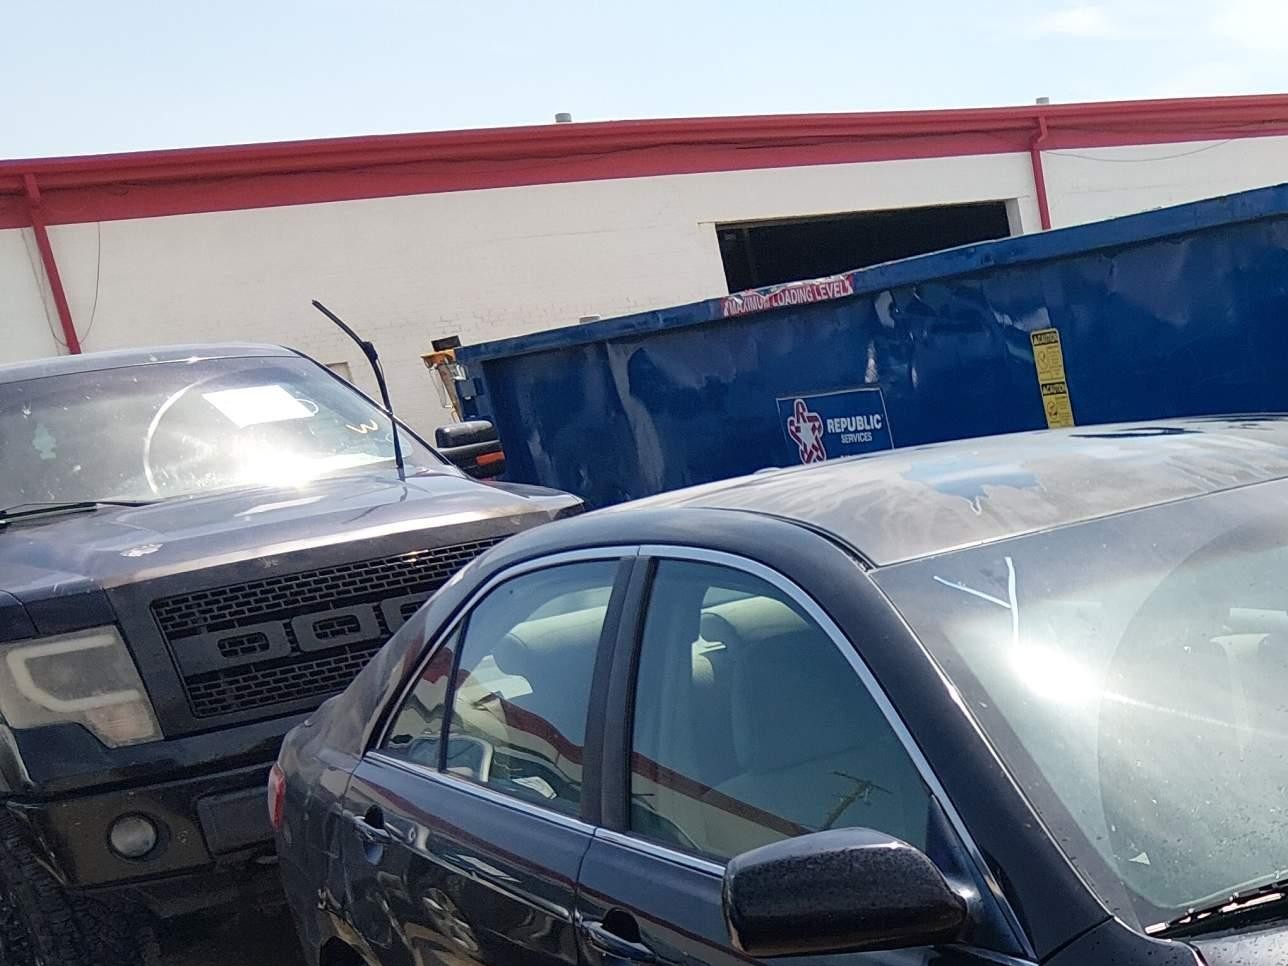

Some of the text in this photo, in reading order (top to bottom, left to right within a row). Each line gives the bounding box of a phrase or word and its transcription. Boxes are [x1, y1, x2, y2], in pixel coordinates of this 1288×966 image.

[773, 285, 812, 307] LOADING
[814, 281, 847, 301] LEVEL
[826, 413, 882, 434] REPUBLIC
[841, 432, 873, 444] SERVICES
